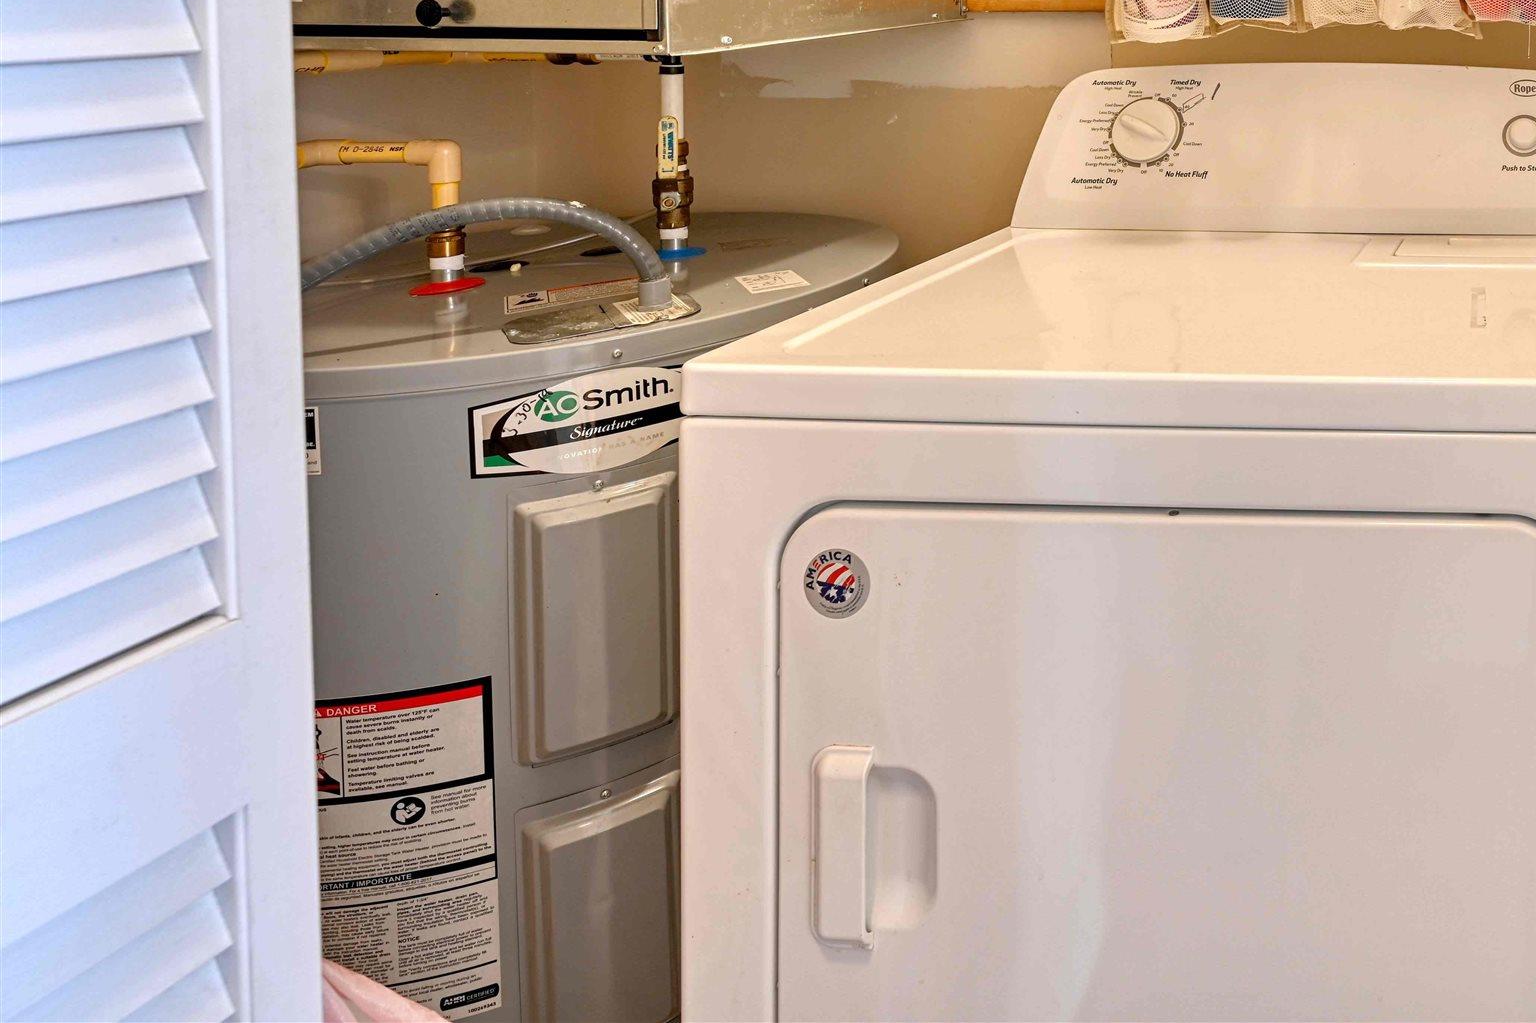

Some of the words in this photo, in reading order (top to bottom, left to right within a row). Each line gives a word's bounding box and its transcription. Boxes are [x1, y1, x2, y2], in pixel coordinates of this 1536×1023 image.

[1126, 80, 1137, 88] Dry
[1190, 80, 1202, 88] Dry
[353, 145, 384, 153] D-2846
[1176, 170, 1191, 178] Heat
[1192, 170, 1209, 180] Fluff
[1071, 177, 1104, 186] Automatic
[1105, 177, 1118, 187] Dry
[570, 420, 634, 440] Signature
[806, 551, 853, 591] AMERICA
[326, 704, 378, 717] DANGER
[363, 715, 396, 723] temperature
[401, 716, 425, 724] instantly
[373, 733, 397, 741] disabled
[410, 729, 429, 737] elderly
[353, 741, 373, 749] highest
[394, 736, 410, 744] being
[356, 873, 412, 887] IMPORTANTE
[398, 935, 420, 944] NOTICE
[466, 987, 495, 1001] CERTIFIED
